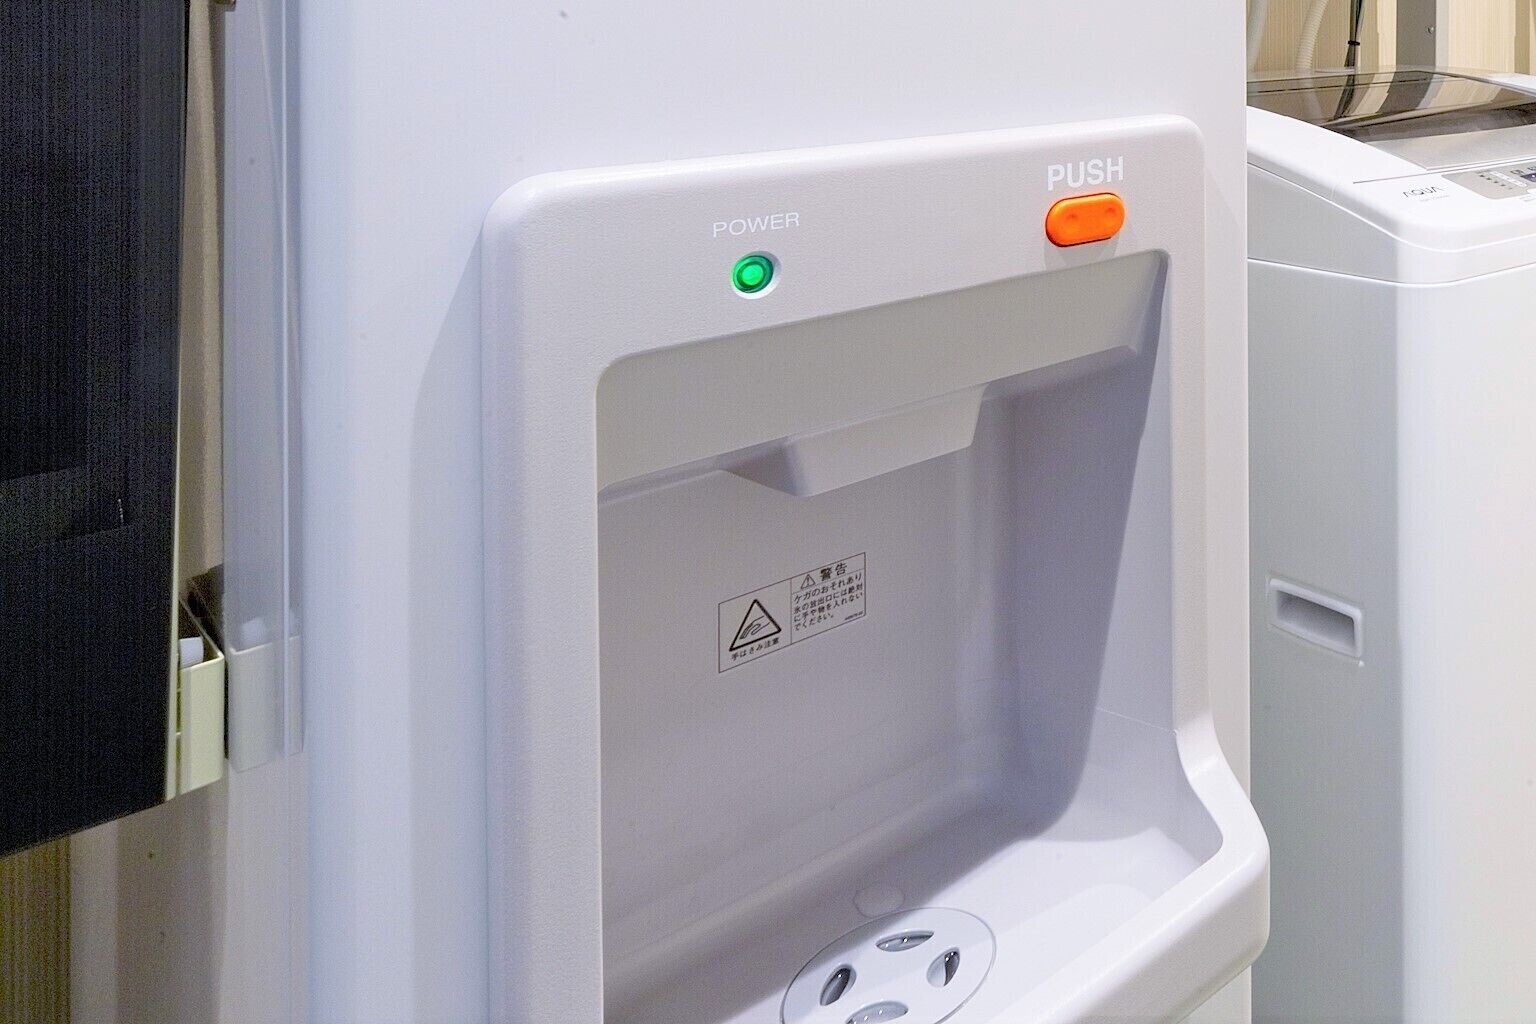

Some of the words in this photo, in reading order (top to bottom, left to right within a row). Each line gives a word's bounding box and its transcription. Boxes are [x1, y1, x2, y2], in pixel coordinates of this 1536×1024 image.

[1047, 156, 1124, 191] PUSH
[712, 212, 799, 238] POWER
[820, 562, 847, 581] 警告
